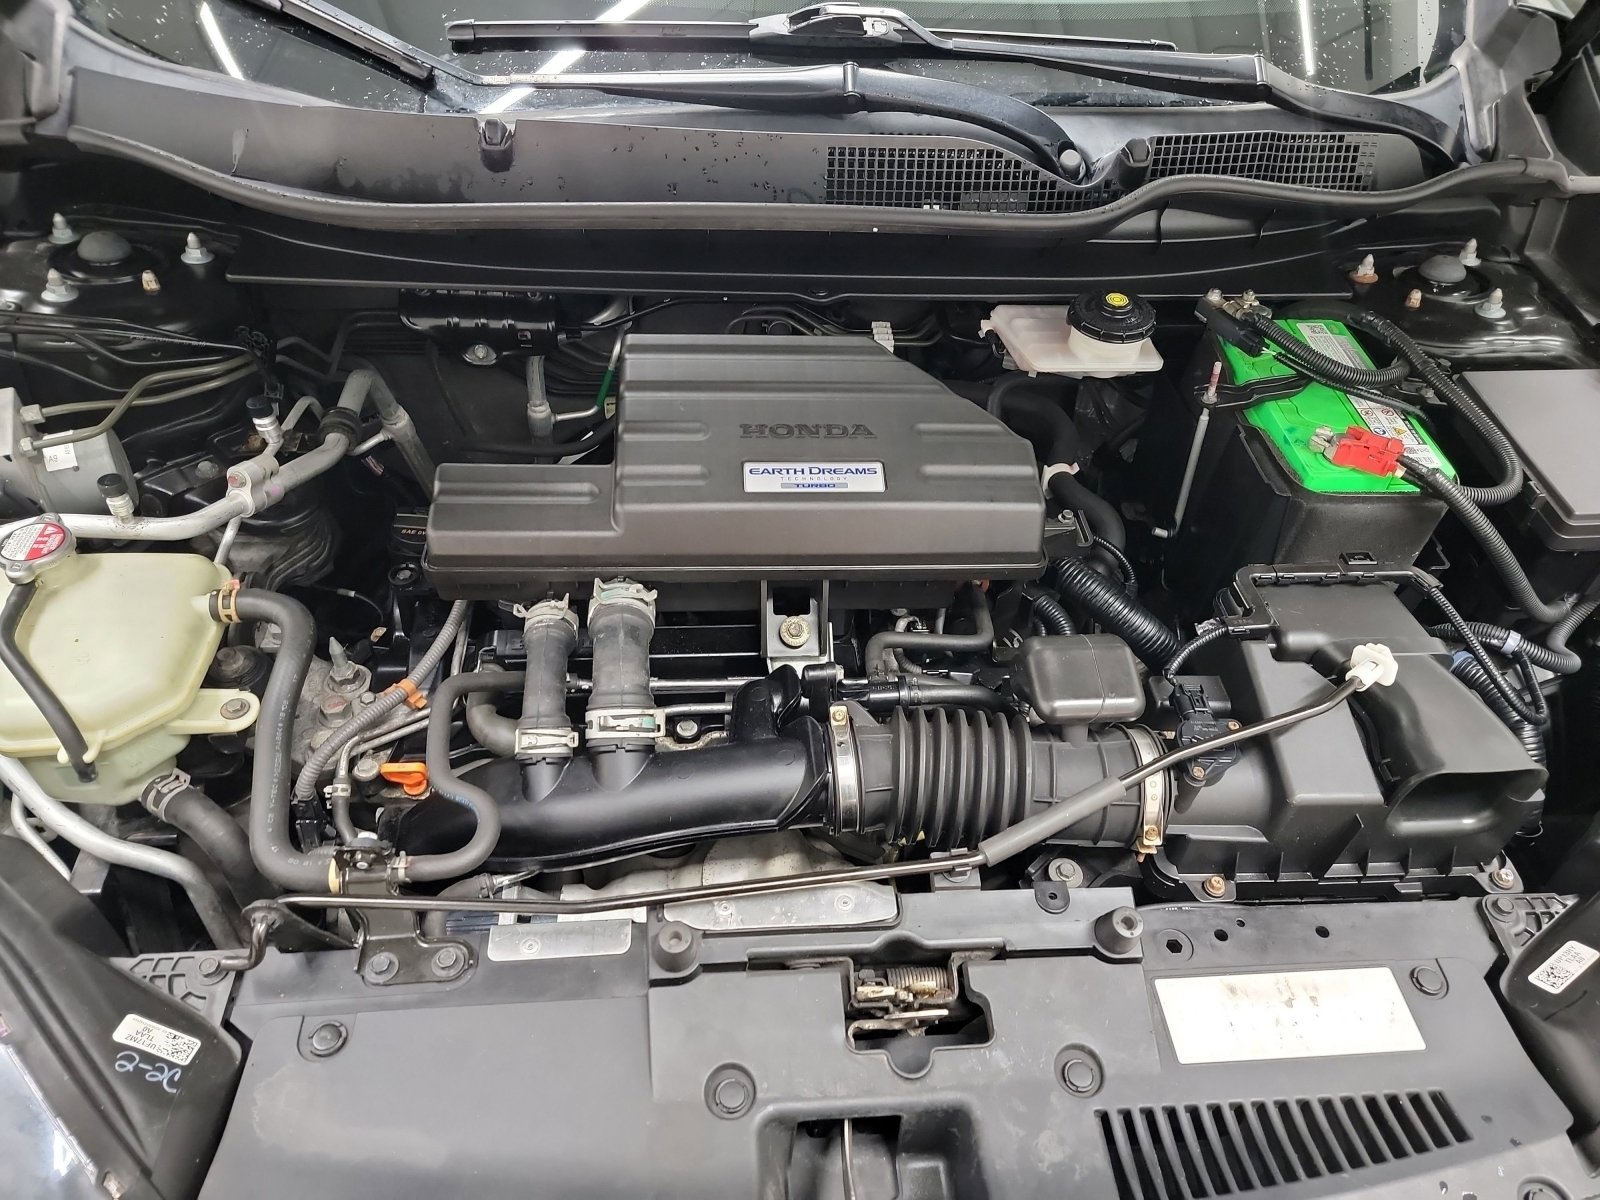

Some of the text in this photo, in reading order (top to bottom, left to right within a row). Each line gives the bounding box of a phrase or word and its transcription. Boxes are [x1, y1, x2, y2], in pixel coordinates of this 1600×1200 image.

[739, 423, 878, 439] HONDA
[749, 466, 877, 475] EARTH DREAMS
[135, 1029, 154, 1042] TLAA
